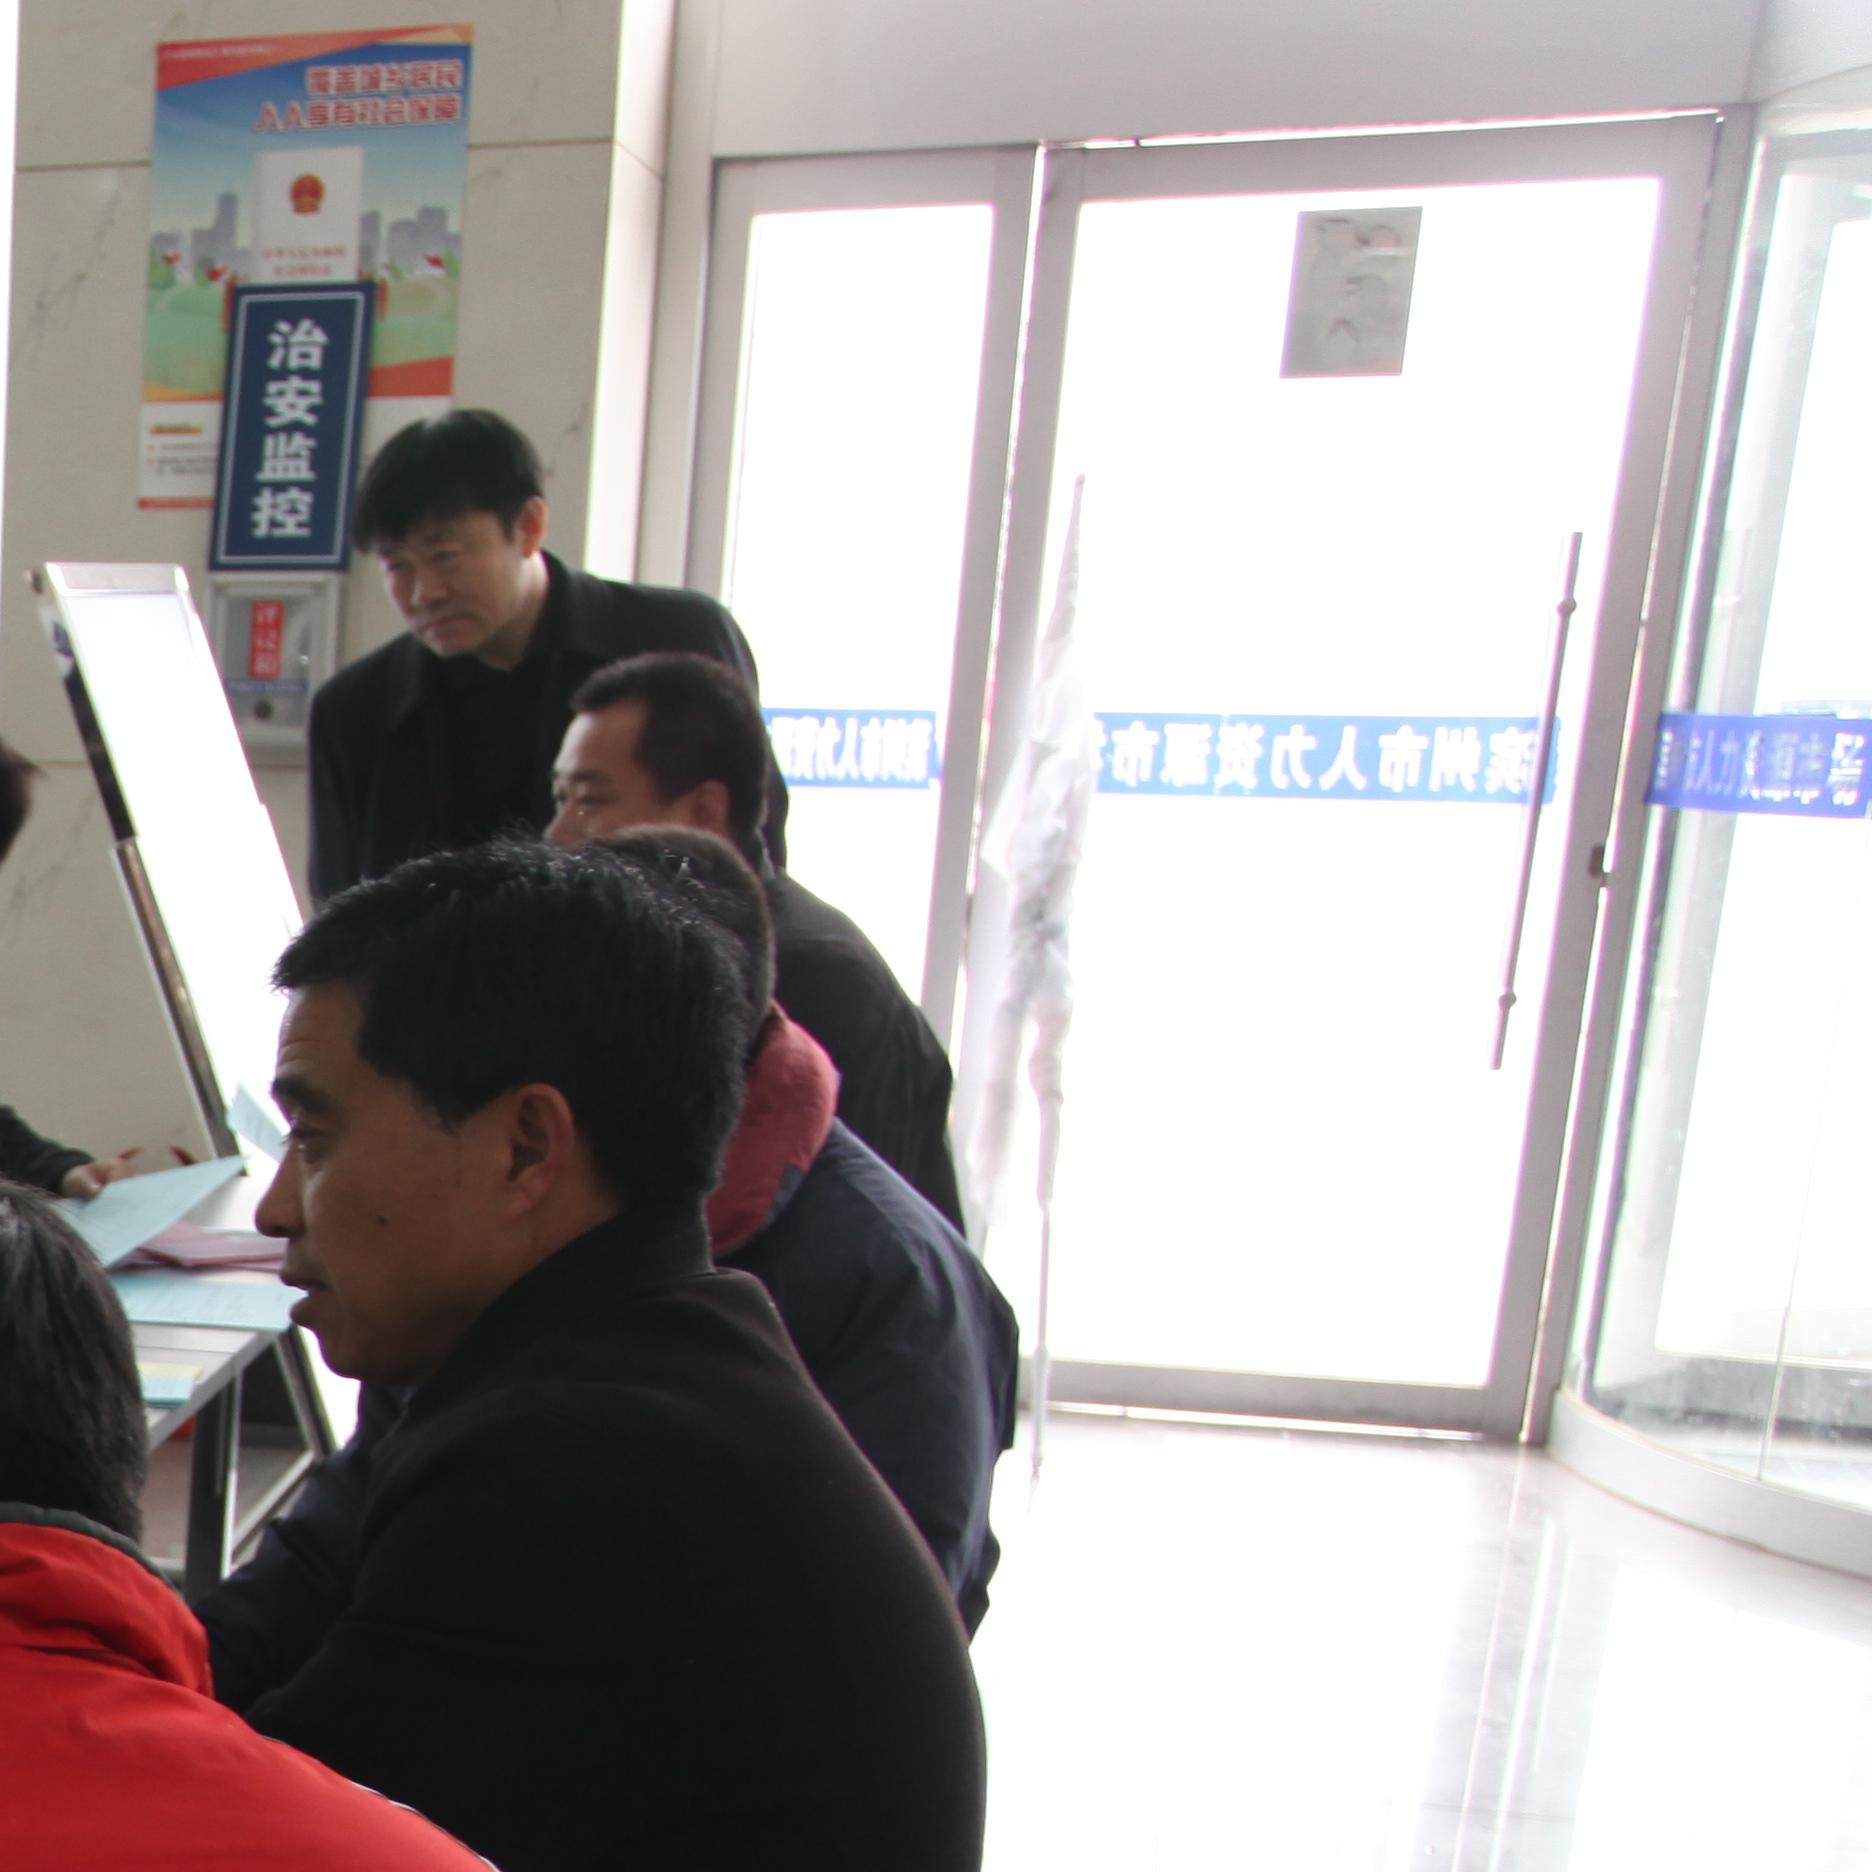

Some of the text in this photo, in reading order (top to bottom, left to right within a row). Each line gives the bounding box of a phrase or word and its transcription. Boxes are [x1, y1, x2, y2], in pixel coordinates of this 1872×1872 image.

[254, 93, 462, 134] 人人享有社会保障
[250, 319, 331, 538] 治安监控
